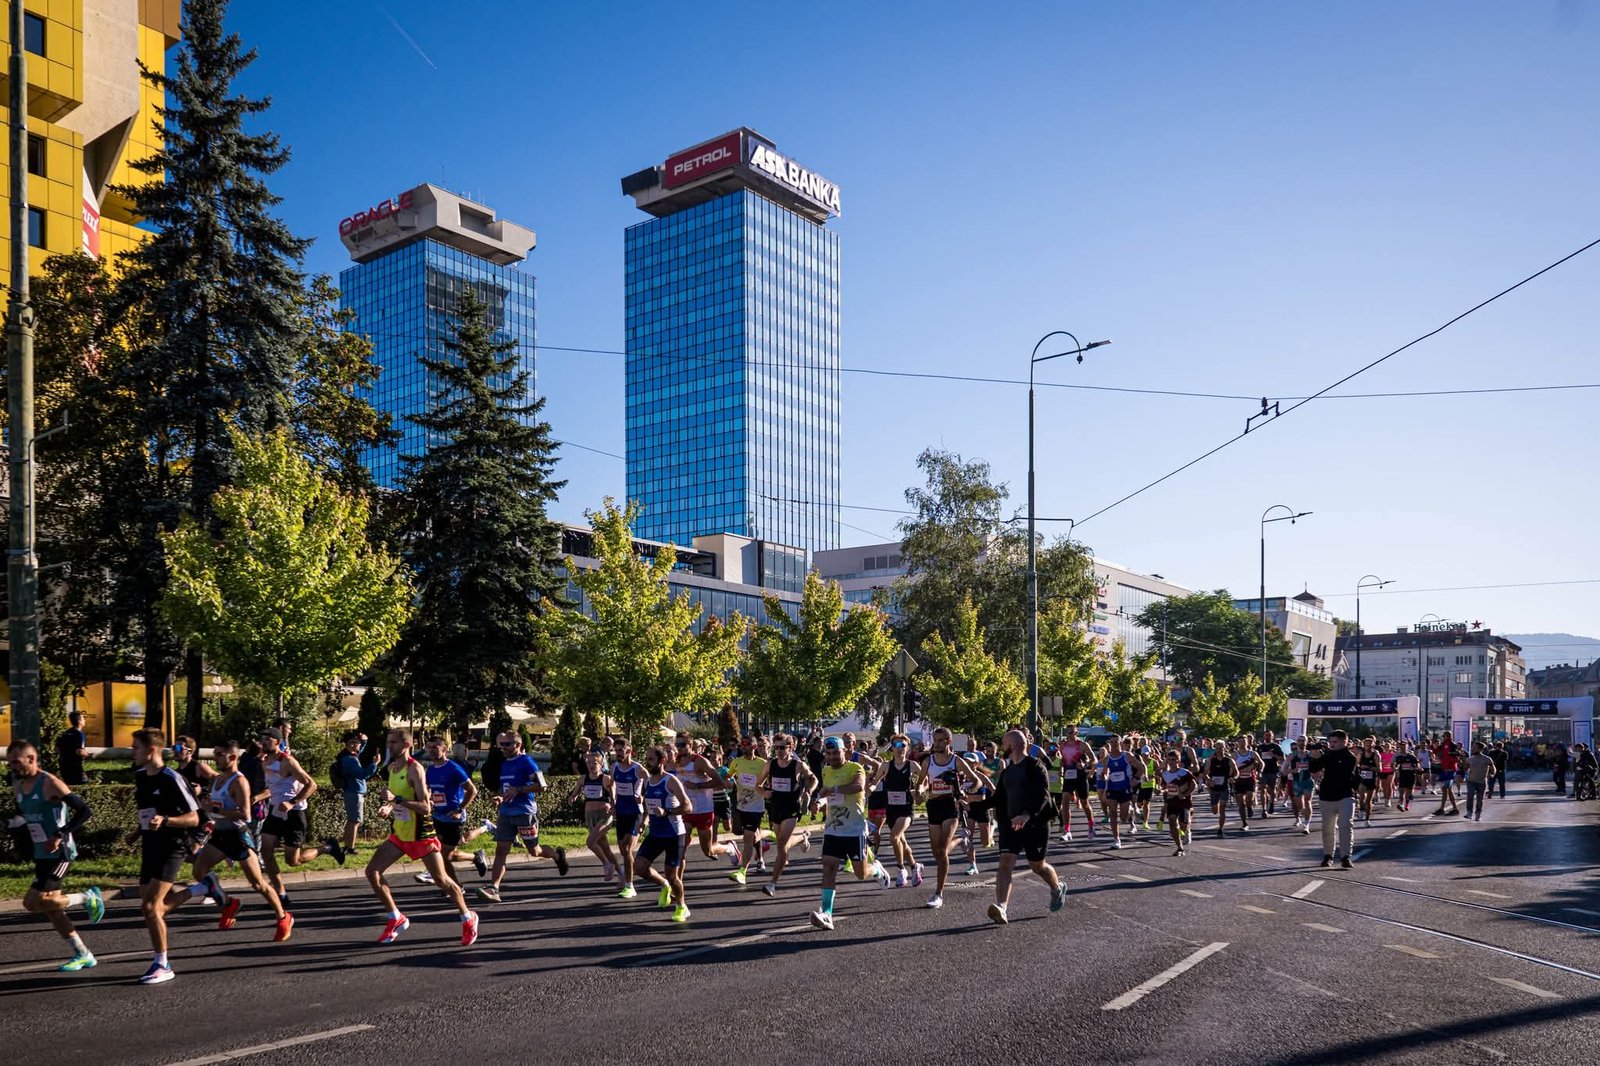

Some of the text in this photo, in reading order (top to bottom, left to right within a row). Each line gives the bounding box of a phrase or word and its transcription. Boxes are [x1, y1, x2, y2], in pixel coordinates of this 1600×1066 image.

[674, 147, 732, 176] PETROL
[339, 192, 413, 236] ORACLE
[1413, 621, 1467, 632] Heineken
